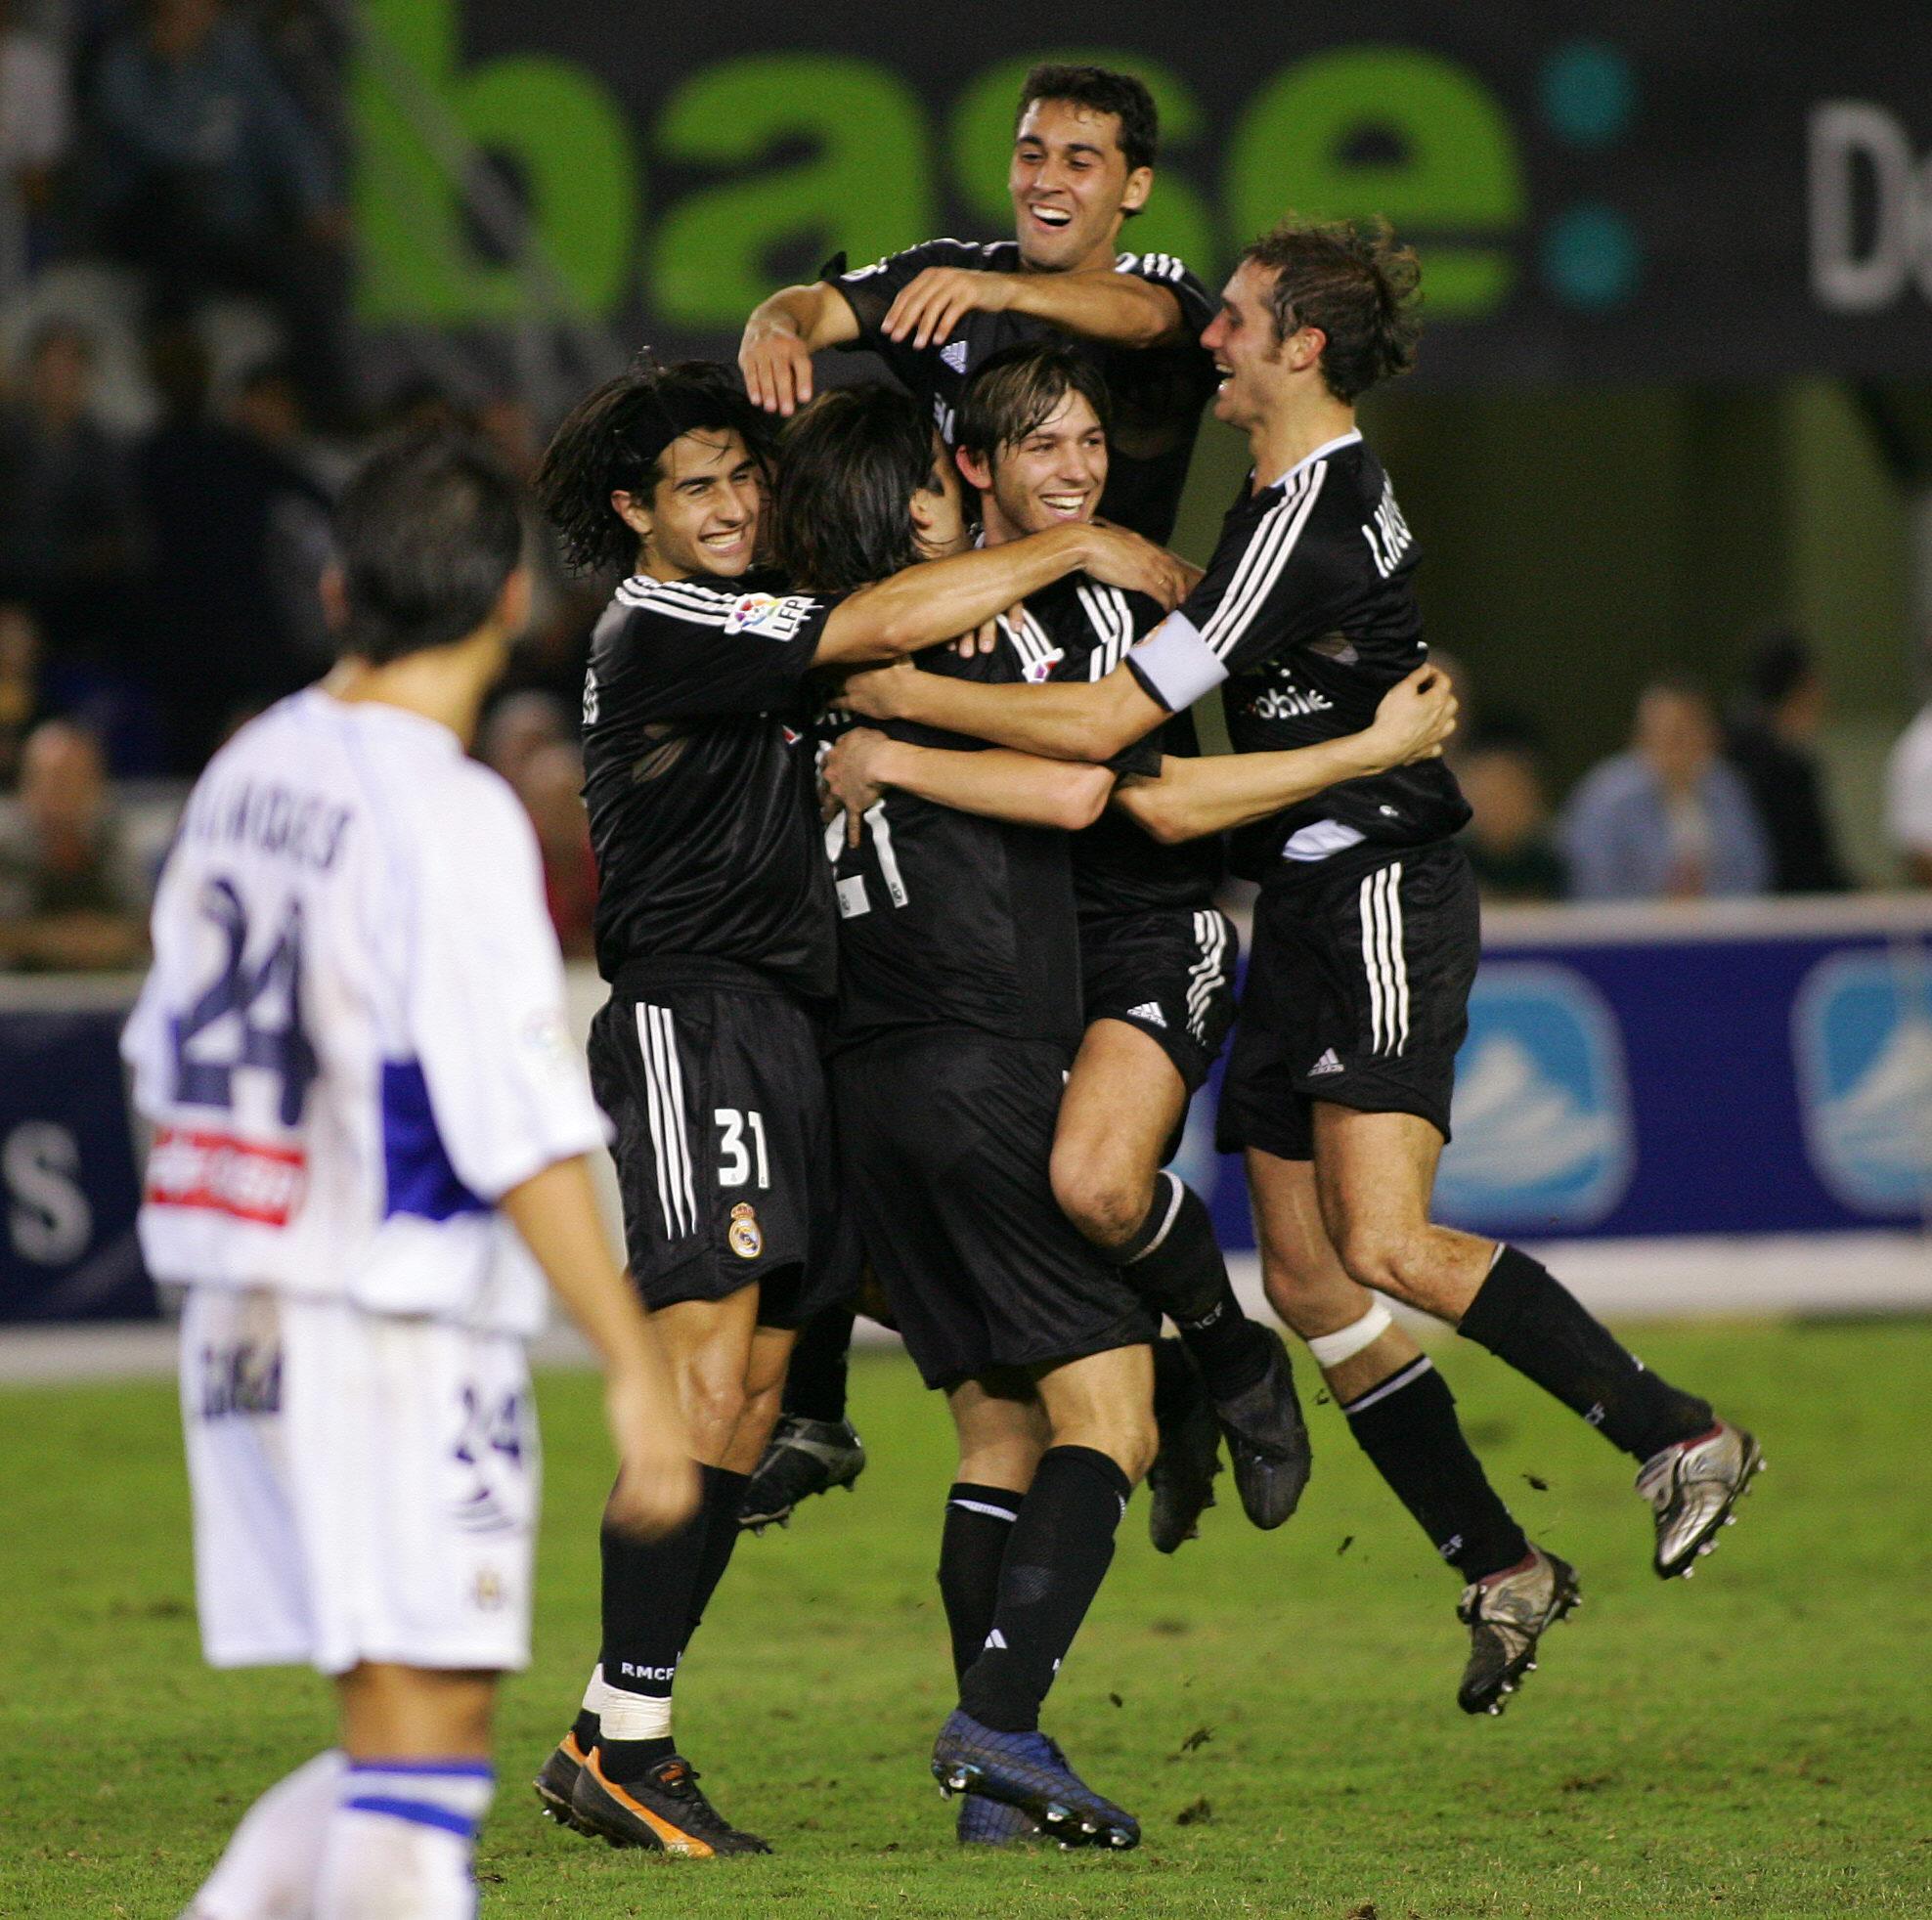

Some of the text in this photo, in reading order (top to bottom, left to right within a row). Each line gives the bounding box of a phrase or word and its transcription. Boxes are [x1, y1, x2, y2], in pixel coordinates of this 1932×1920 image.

[771, 599, 805, 633] LFP
[1254, 687, 1333, 720] obile
[173, 876, 320, 1126] 24
[714, 1109, 769, 1190] 31
[454, 1382, 534, 1470] 24
[621, 1662, 676, 1680] RMCF
